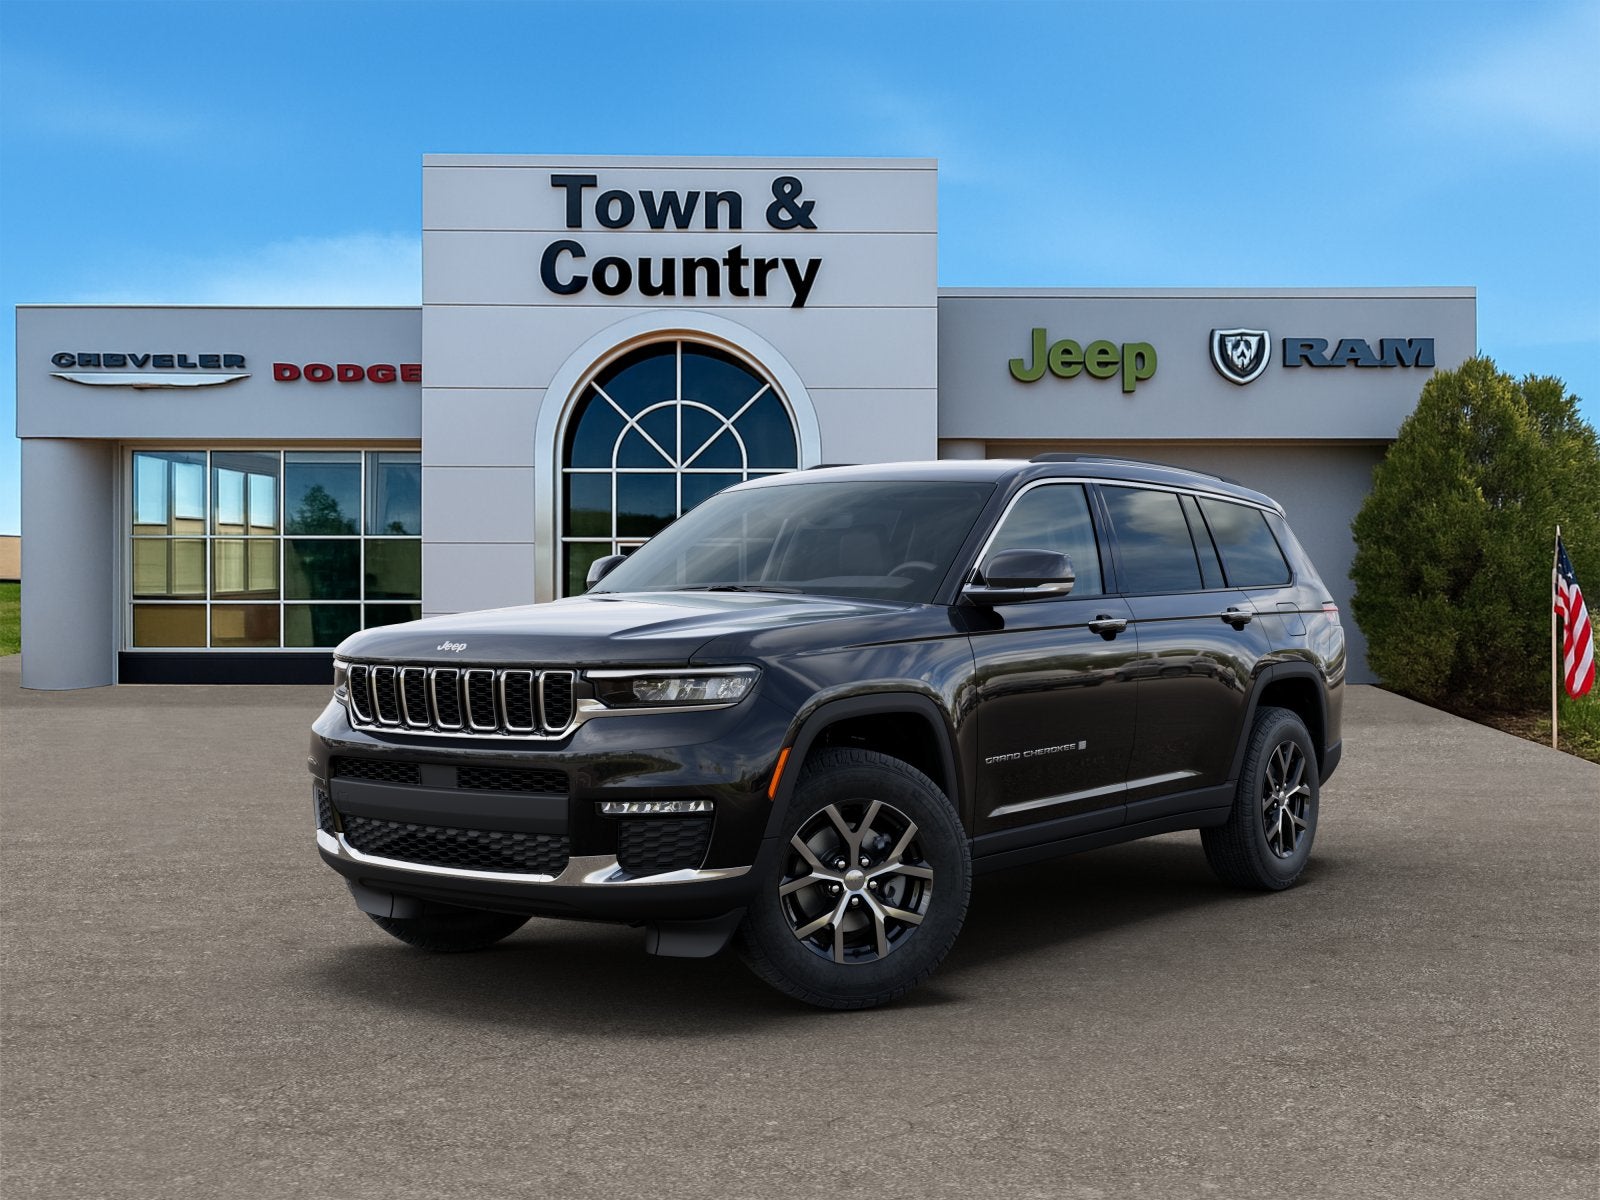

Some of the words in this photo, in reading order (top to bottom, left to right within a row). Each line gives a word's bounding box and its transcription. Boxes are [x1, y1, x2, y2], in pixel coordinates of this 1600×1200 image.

[550, 174, 743, 229] Town
[766, 176, 818, 229] &
[540, 239, 822, 308] Country
[1009, 328, 1157, 393] Jeep
[1282, 337, 1436, 368] RAM
[273, 362, 422, 383] DODGE
[437, 640, 467, 653] Jeep
[985, 752, 1021, 764] GRAND
[1023, 743, 1076, 758] CHEROKEE
